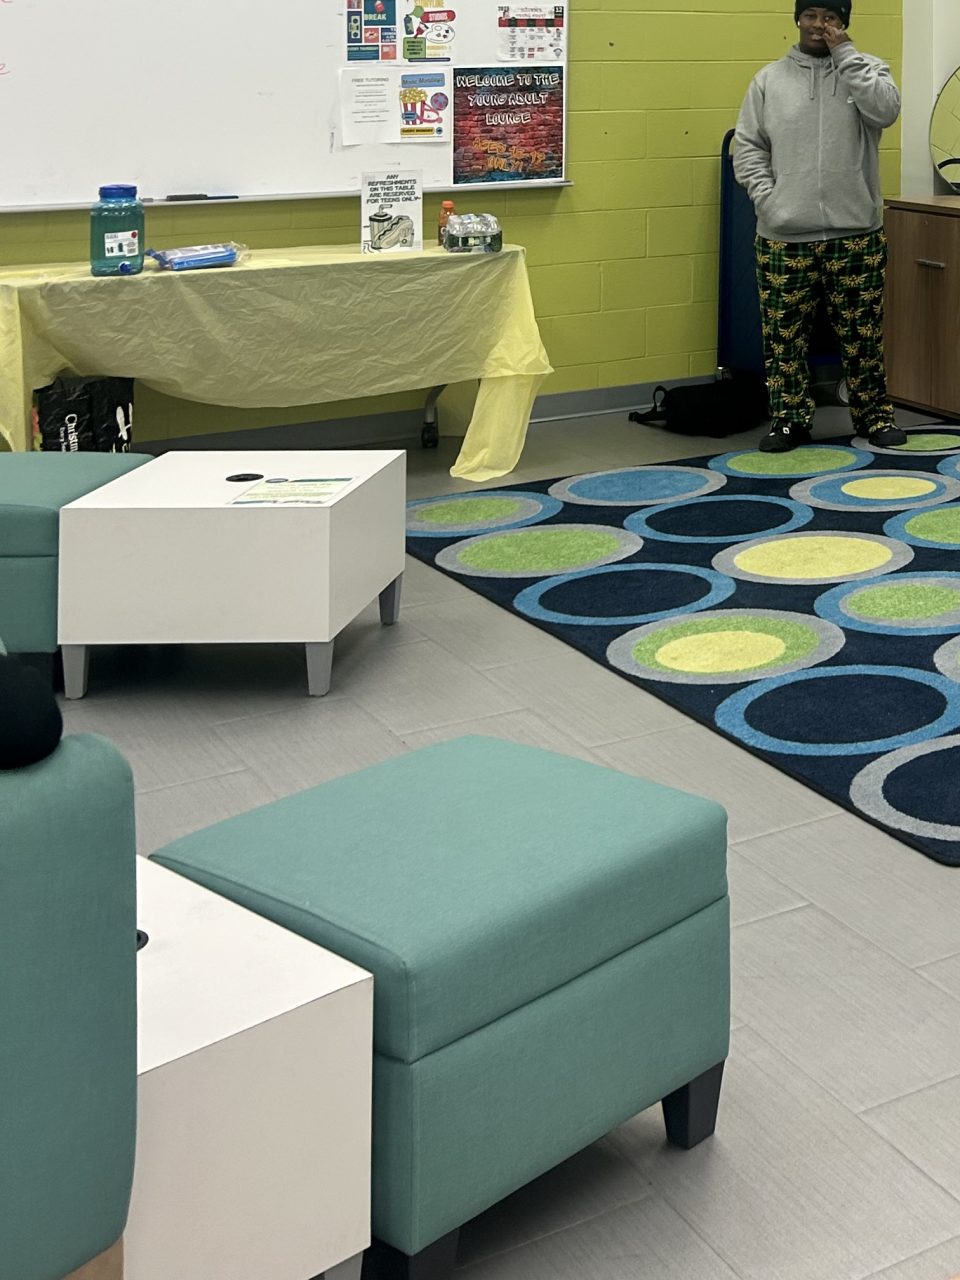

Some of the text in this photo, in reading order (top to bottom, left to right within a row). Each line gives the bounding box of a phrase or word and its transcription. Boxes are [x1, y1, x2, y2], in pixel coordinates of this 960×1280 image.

[456, 72, 560, 88] WELCOME TO THE
[468, 92, 548, 106] YOUNG ADULT
[485, 112, 531, 125] LOUNGE
[368, 179, 417, 187] REFRESHMENTS
